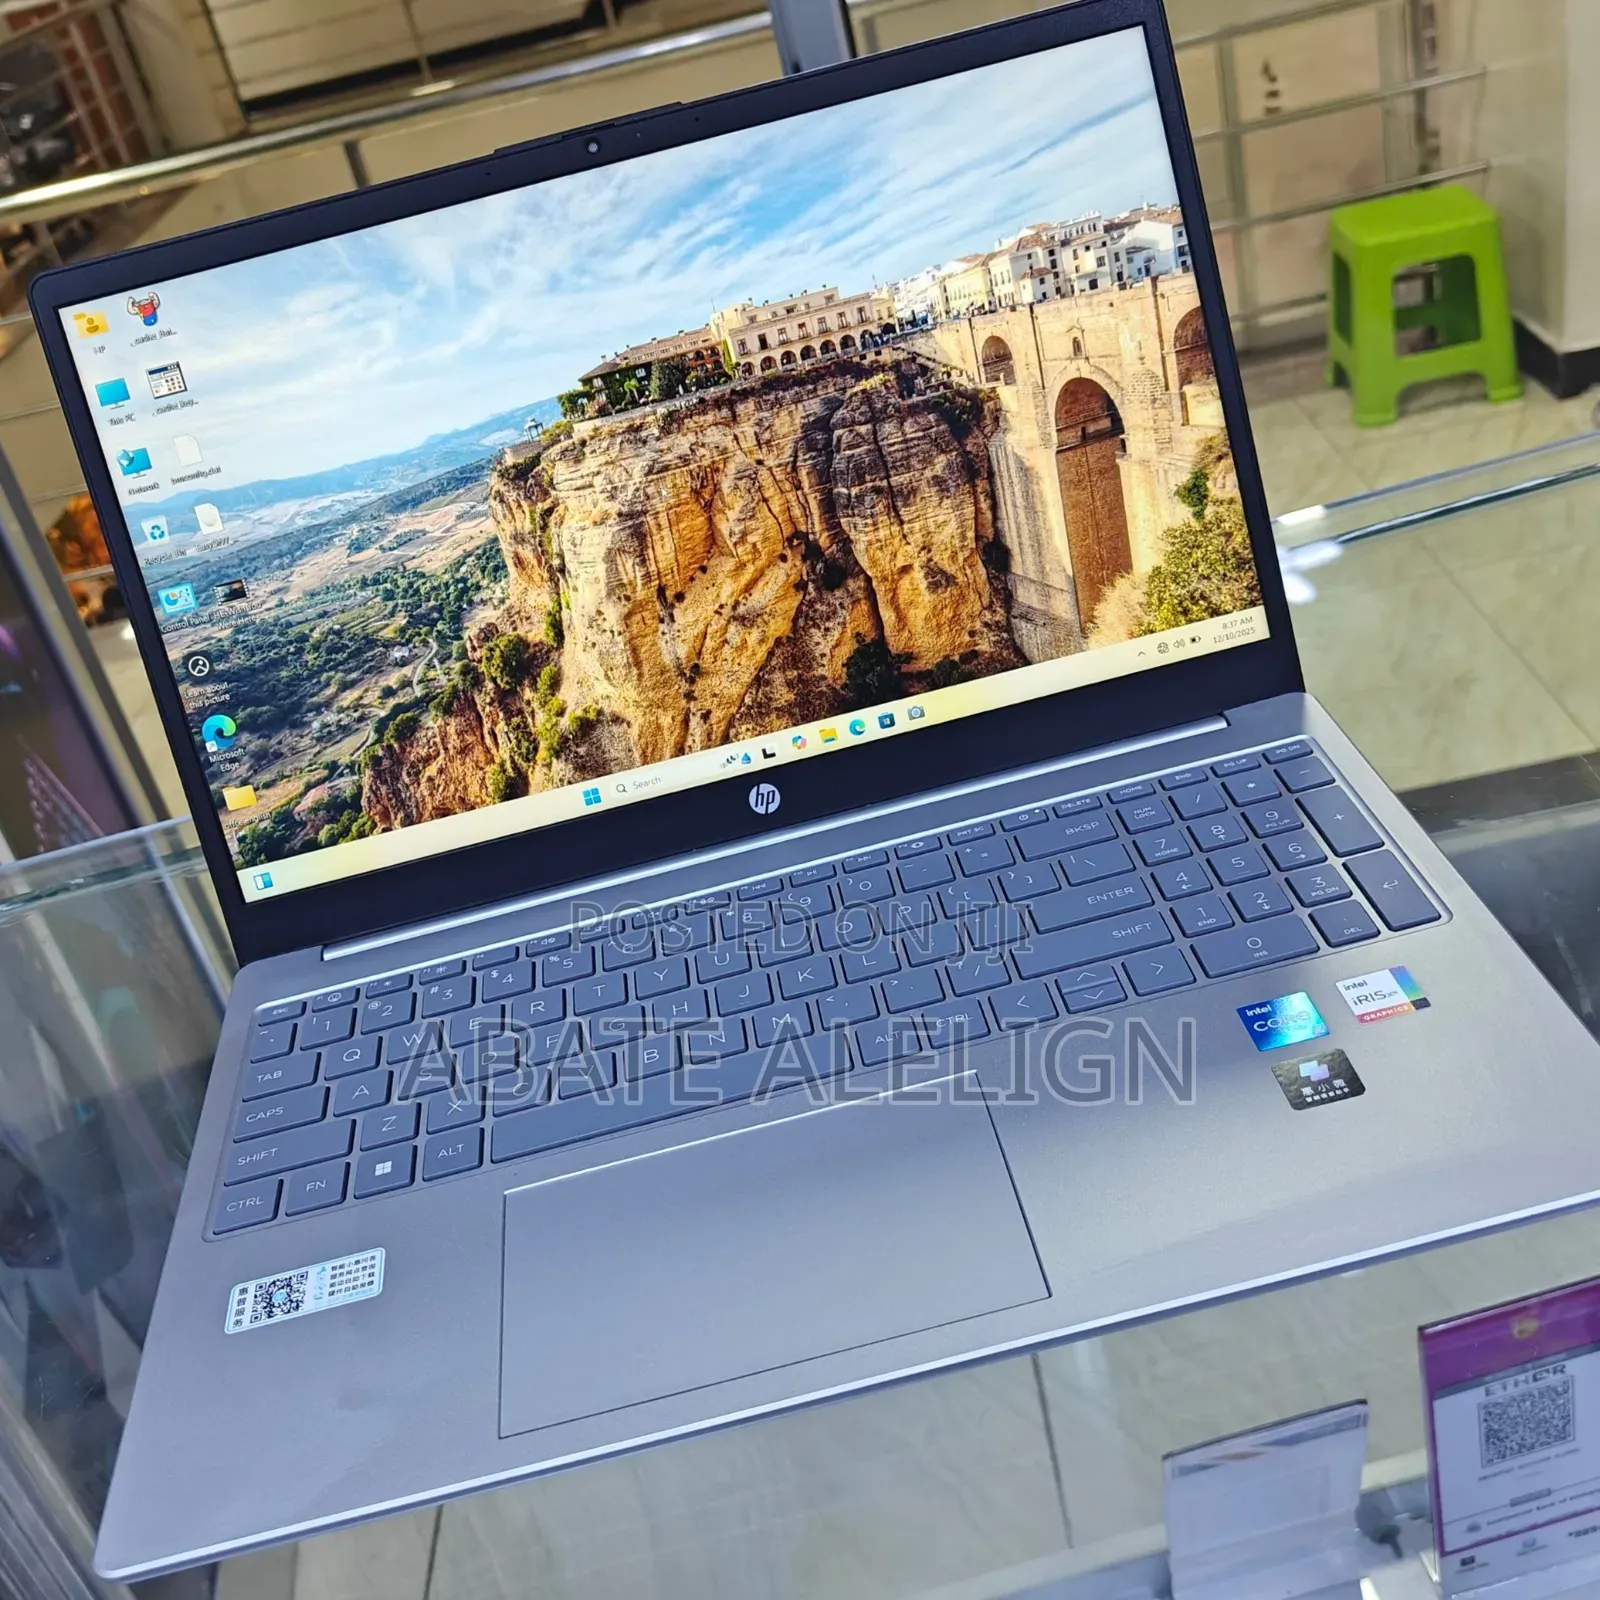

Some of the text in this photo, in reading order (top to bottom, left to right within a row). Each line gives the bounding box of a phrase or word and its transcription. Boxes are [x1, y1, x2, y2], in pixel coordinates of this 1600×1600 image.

[161, 614, 210, 633] Control Panel
[1222, 616, 1253, 630] 8:37 AM
[1213, 627, 1255, 644] 12/10/2025
[184, 681, 229, 699] Learn about
[189, 693, 231, 710] this picture
[208, 748, 245, 763] Microsoft
[220, 762, 240, 773] Edge
[632, 775, 661, 790] Search
[1175, 772, 1192, 781] END
[1119, 785, 1143, 794] HOME
[749, 783, 781, 815] hp
[1061, 798, 1092, 810] DELETE
[1133, 806, 1152, 815] NUM
[1134, 810, 1157, 820] LOCK
[1265, 811, 1279, 821] 9
[957, 826, 985, 837] PRT SC
[1065, 821, 1100, 836] BKSP
[1211, 825, 1225, 836] 8
[1154, 838, 1167, 850] 7
[1288, 842, 1302, 854] 6
[1154, 847, 1179, 857] HOME
[1231, 857, 1245, 868] 5
[1175, 872, 1189, 883] 4
[1311, 876, 1326, 889] 3
[1087, 886, 1135, 905] ENTER
[1252, 891, 1266, 904] 2
[1311, 886, 1340, 897] PG DN
[800, 896, 811, 906] 9
[742, 911, 753, 922] 8
[1197, 907, 1207, 917] 1
[836, 921, 853, 934] O
[1197, 917, 1217, 927] END
[1111, 922, 1151, 939] SHIFT
[1343, 926, 1363, 935] DEL
[622, 943, 634, 954] 6
[1252, 950, 1269, 958] INS
[562, 958, 574, 969] 5
[714, 953, 730, 966] U
[863, 955, 877, 966] L
[501, 973, 515, 984] 4
[653, 969, 669, 982] Y
[798, 968, 815, 982] K
[592, 985, 606, 998] T
[738, 984, 749, 998] J
[1343, 980, 1369, 991] intel
[442, 988, 453, 1000] 3
[272, 1006, 289, 1015] ESC
[368, 1000, 382, 1010] @
[381, 1005, 393, 1016] 2
[530, 1001, 546, 1015] R
[672, 1001, 688, 1016] H
[1246, 1004, 1272, 1017] intel
[1363, 1005, 1408, 1021] GRAPHICS
[323, 1020, 331, 1031] 1
[469, 1017, 482, 1030] E
[609, 1018, 625, 1032] G
[772, 1013, 792, 1029] M
[935, 1012, 975, 1029] CTRL
[402, 1032, 423, 1047] W
[546, 1034, 560, 1048] F
[708, 1031, 726, 1046] N
[875, 1031, 901, 1045] ALT
[342, 1049, 361, 1062] Q
[481, 1052, 497, 1065] D
[644, 1049, 659, 1064] B
[256, 1070, 282, 1083] TAB
[419, 1068, 433, 1081] S
[578, 1066, 594, 1079] V
[352, 1085, 370, 1099] A
[512, 1082, 529, 1097] C
[447, 1100, 463, 1115] X
[246, 1107, 284, 1123] CAPS
[382, 1116, 397, 1132] Z
[237, 1147, 279, 1166] SHIFT
[437, 1144, 465, 1159] ALT
[306, 1180, 327, 1192] FN
[226, 1197, 264, 1212] CTRL
[232, 1287, 249, 1328] 惠普服务
